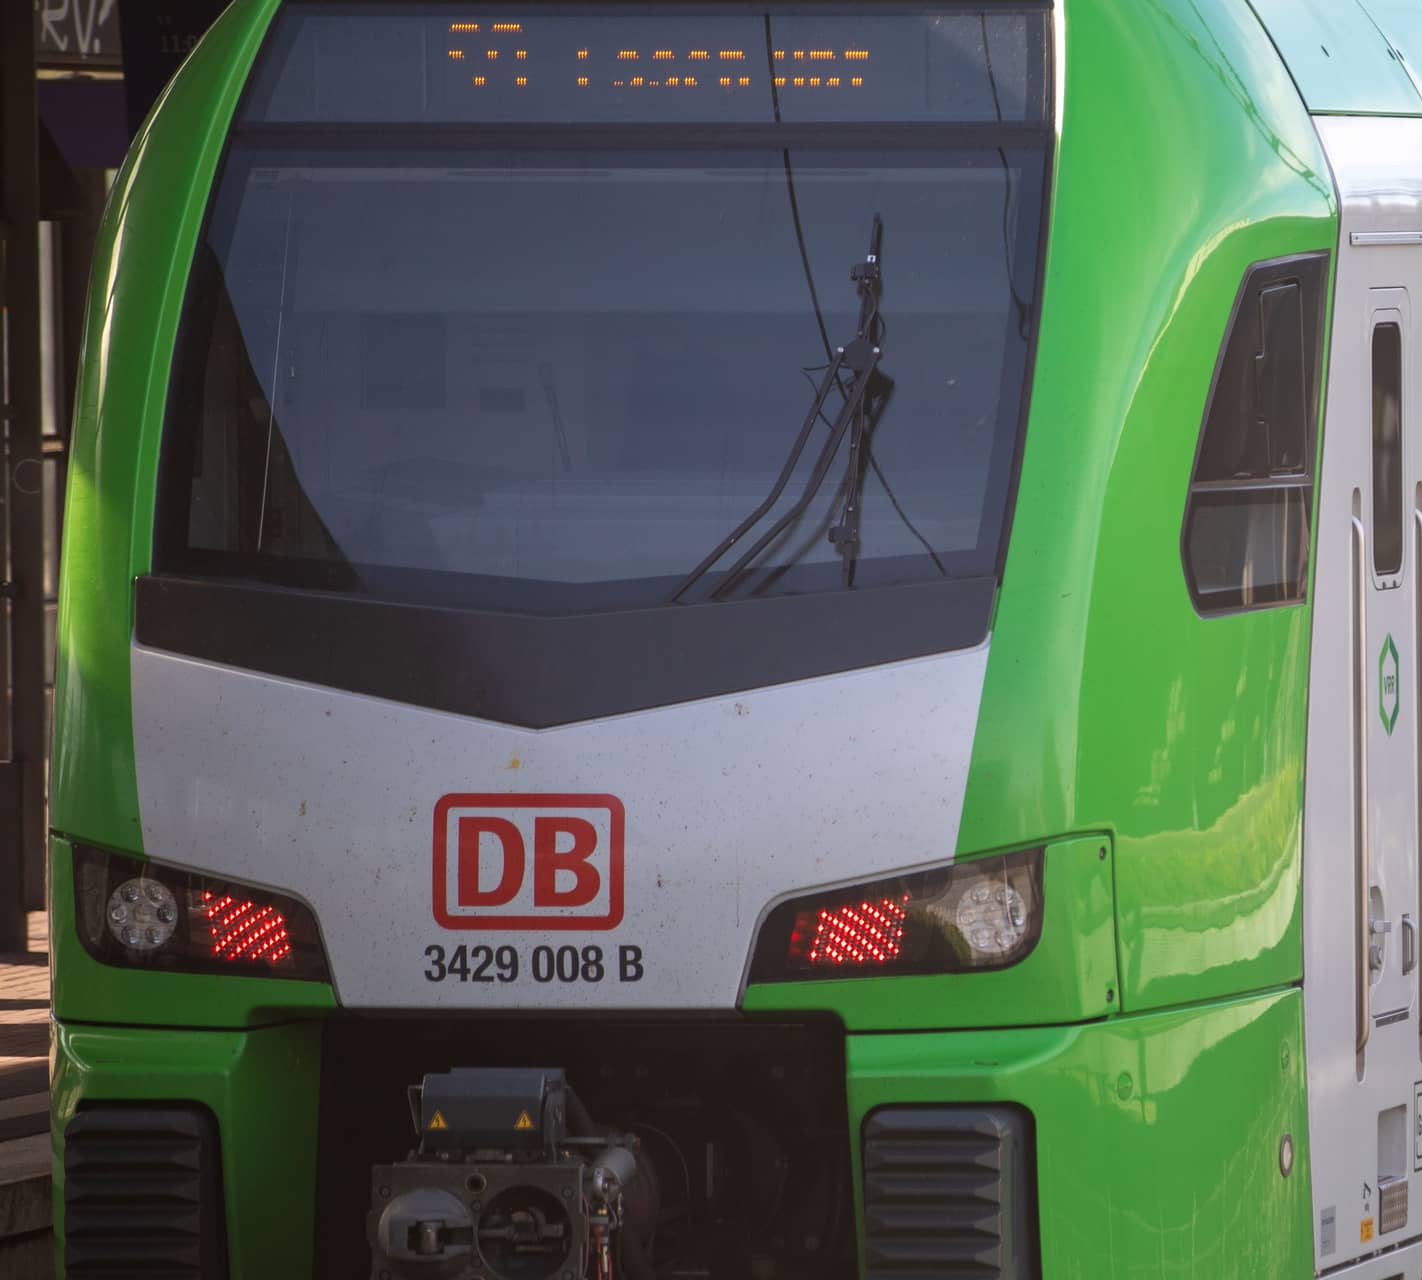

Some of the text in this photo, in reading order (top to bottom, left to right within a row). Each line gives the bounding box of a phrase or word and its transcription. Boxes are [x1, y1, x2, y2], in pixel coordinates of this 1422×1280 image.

[457, 815, 601, 908] DB
[424, 944, 644, 983] 3429 008 B
